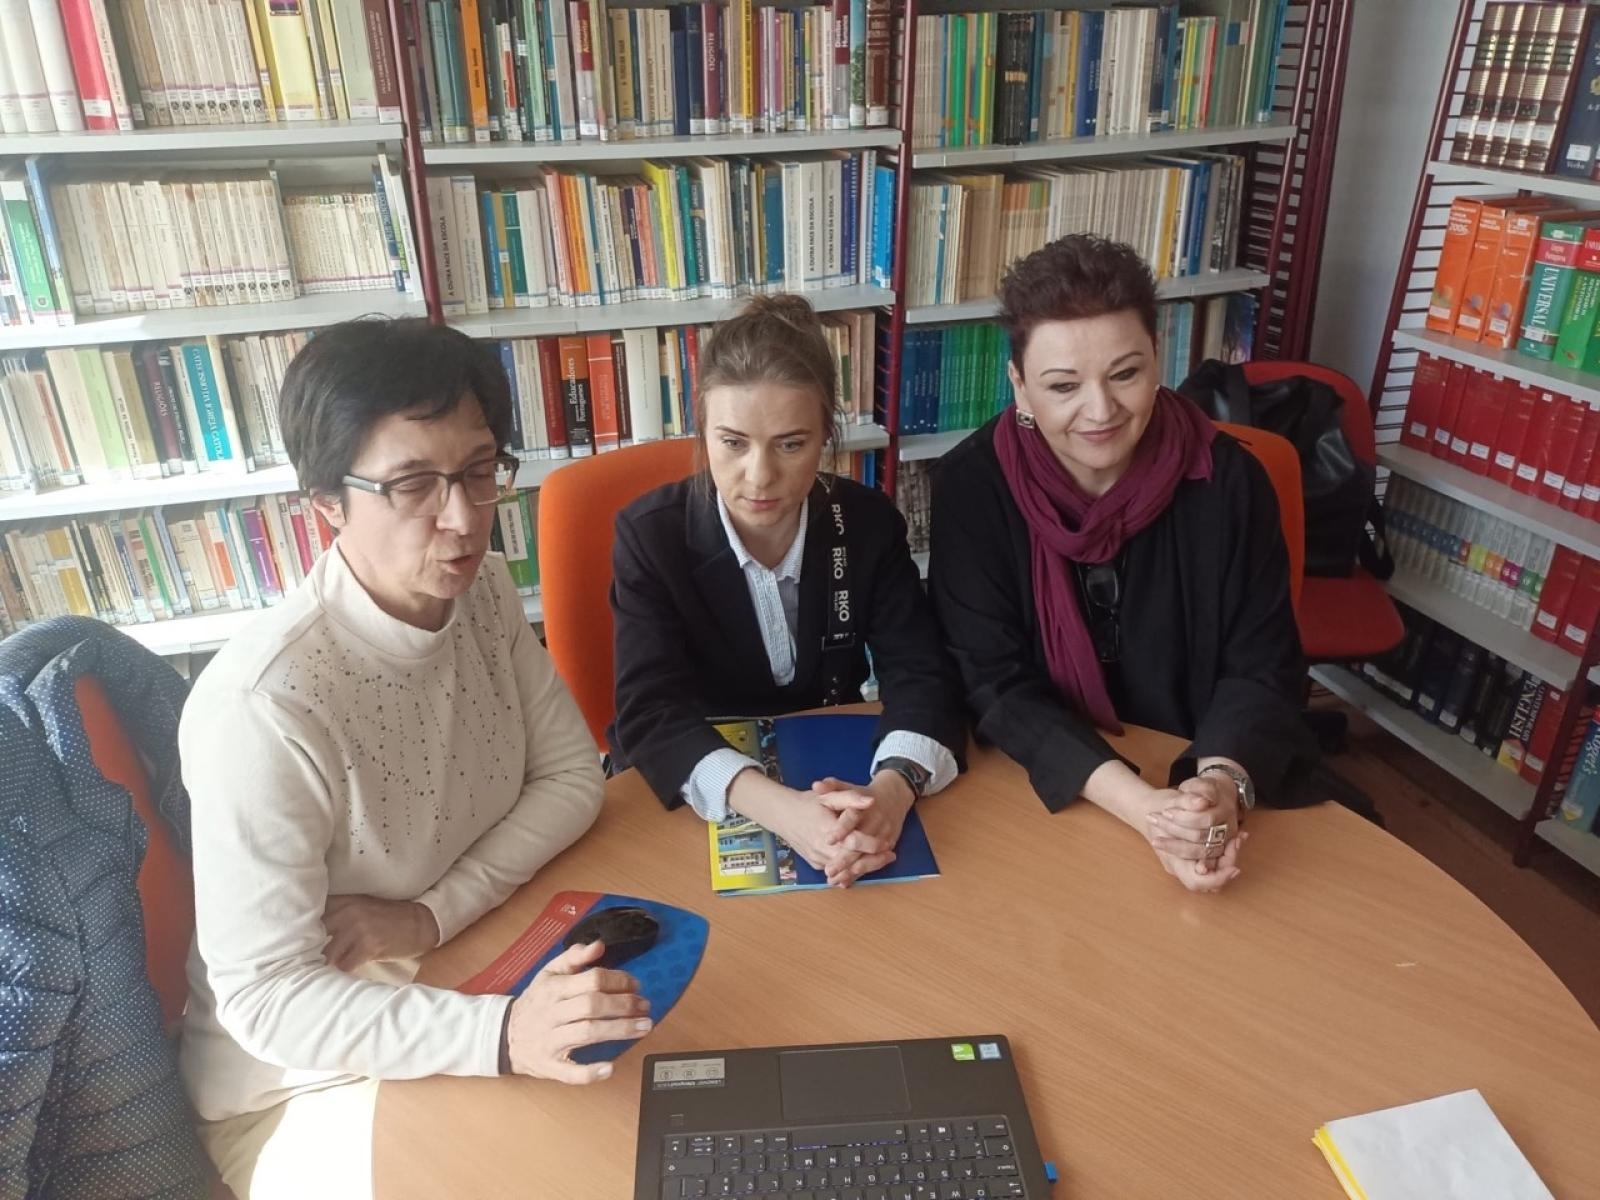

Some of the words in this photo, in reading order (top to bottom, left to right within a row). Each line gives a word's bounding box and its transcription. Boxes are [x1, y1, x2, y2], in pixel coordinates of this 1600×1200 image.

[439, 216, 448, 240] ESCOLA
[443, 252, 451, 267] FACE
[1532, 267, 1560, 326] UNIVERSAL
[567, 357, 578, 405] Educadores
[578, 383, 586, 422] Portugueses
[832, 547, 844, 580] RKO
[838, 590, 850, 622] RKO
[952, 1190, 960, 1198] W
